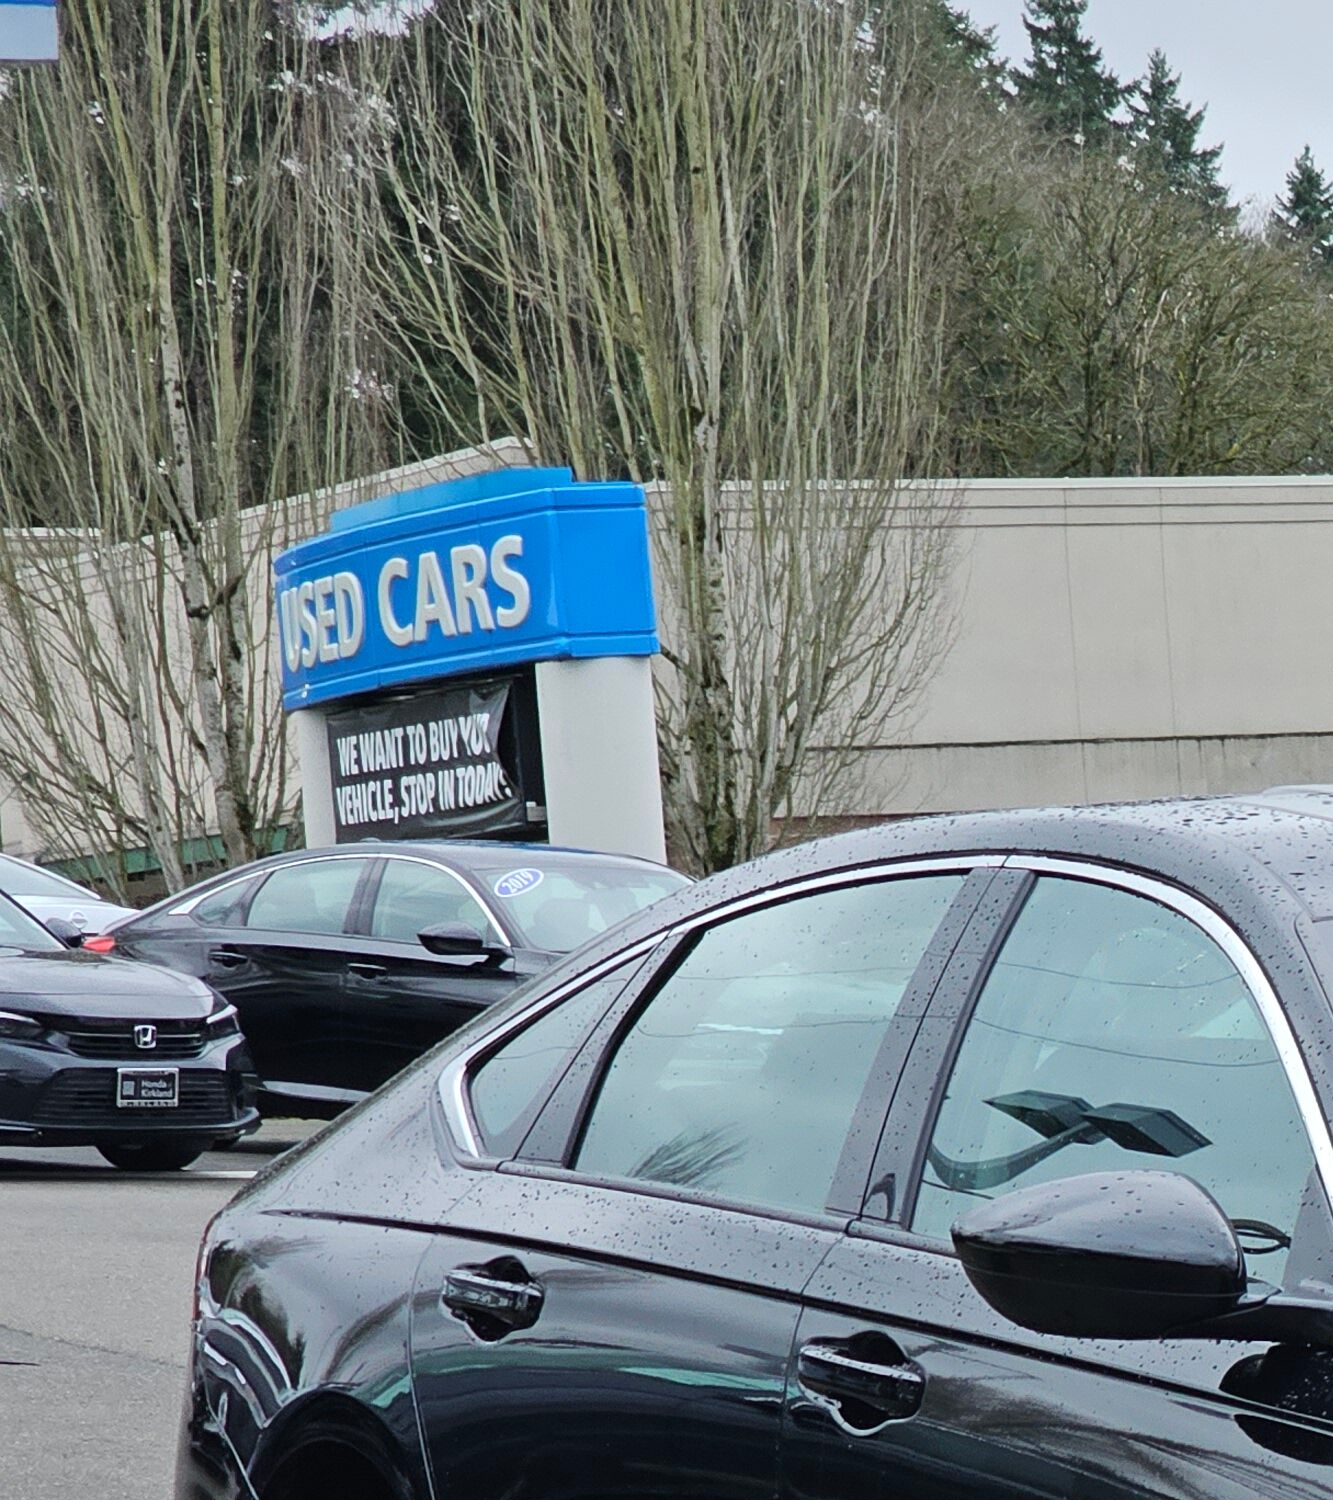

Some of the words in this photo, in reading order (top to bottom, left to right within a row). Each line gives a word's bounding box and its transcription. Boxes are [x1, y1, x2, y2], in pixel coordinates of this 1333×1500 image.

[281, 571, 365, 673] USED
[378, 534, 530, 647] CARS
[337, 735, 359, 777] WE
[359, 727, 404, 773] WANT
[406, 723, 427, 765] TO
[429, 718, 458, 762] BUY
[336, 779, 399, 825] VEHICLE,
[400, 772, 435, 817] STOP
[438, 769, 455, 811] IN
